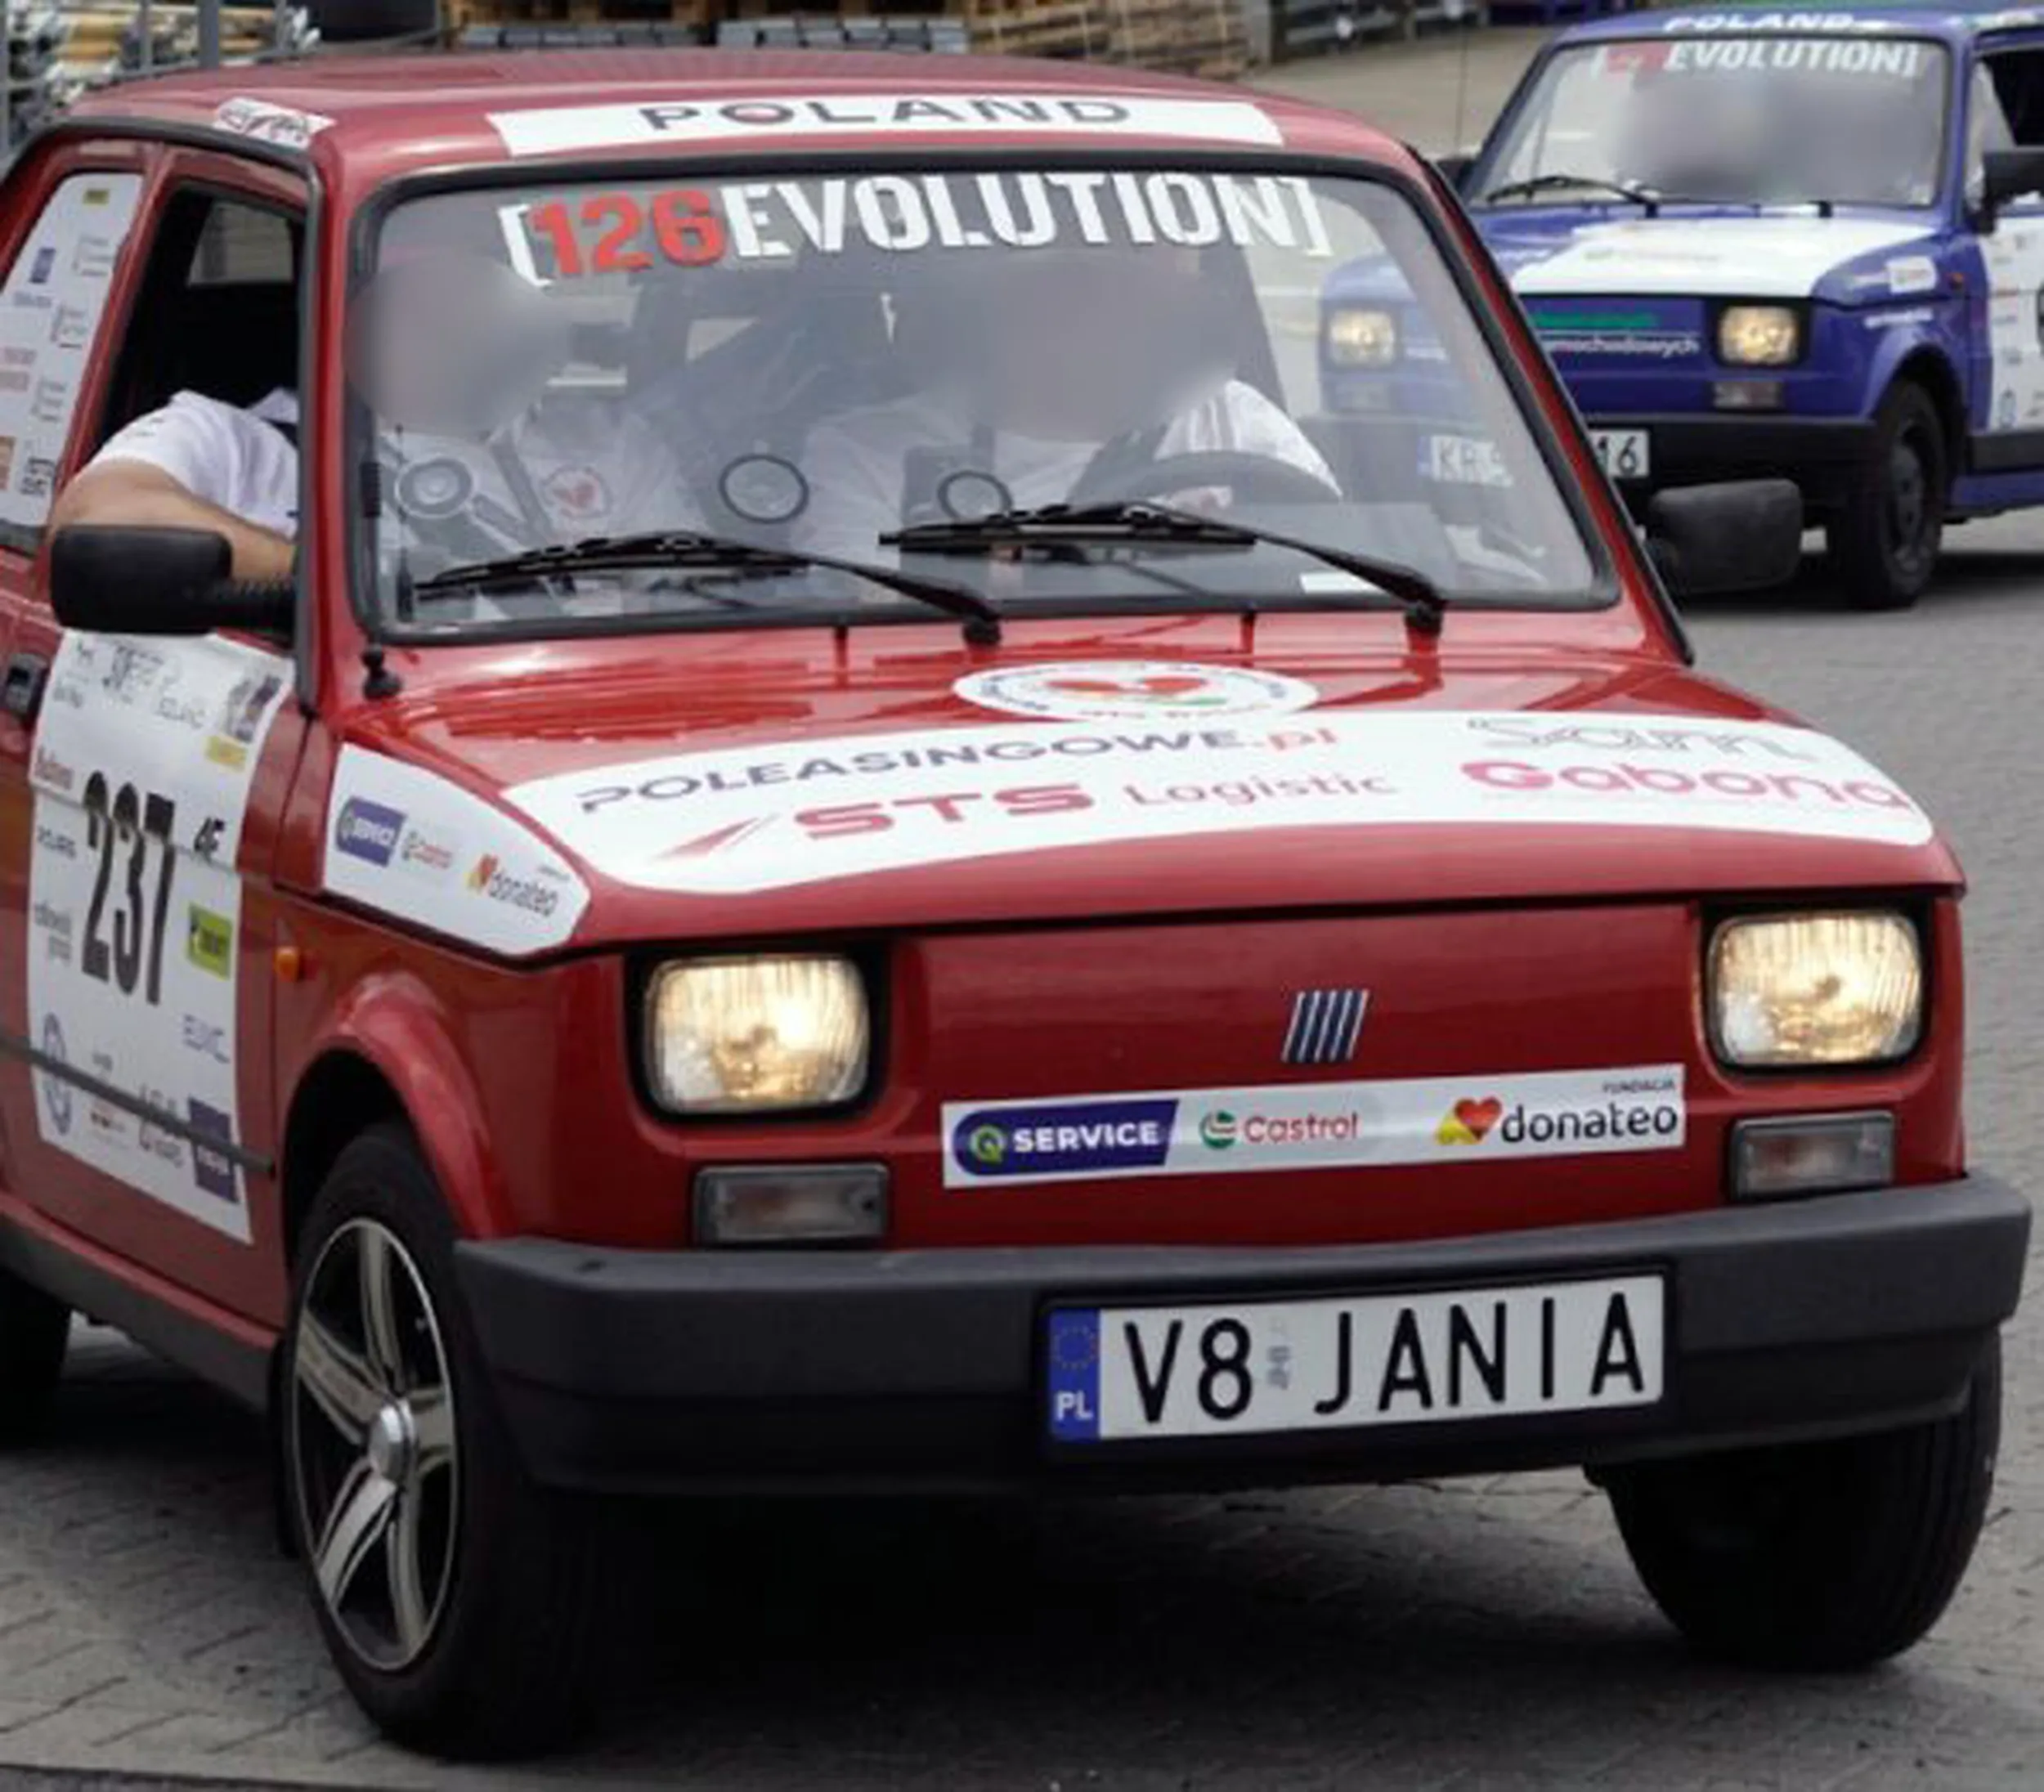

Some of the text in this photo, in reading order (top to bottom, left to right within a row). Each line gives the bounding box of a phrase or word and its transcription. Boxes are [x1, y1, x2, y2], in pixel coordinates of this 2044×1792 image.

[638, 97, 1131, 131] POLAND
[576, 727, 1338, 813] POLEASINGOWE.pl
[1459, 761, 1912, 809] Gabona
[793, 772, 1397, 840] STS Logistic
[84, 770, 175, 1006] 237
[1013, 1120, 1159, 1152] SERVICE
[1243, 1112, 1358, 1144] Castrol
[1501, 1101, 1678, 1143] donateo
[1123, 1292, 1645, 1425] V8 JANIA
[1056, 1392, 1093, 1421] PL
